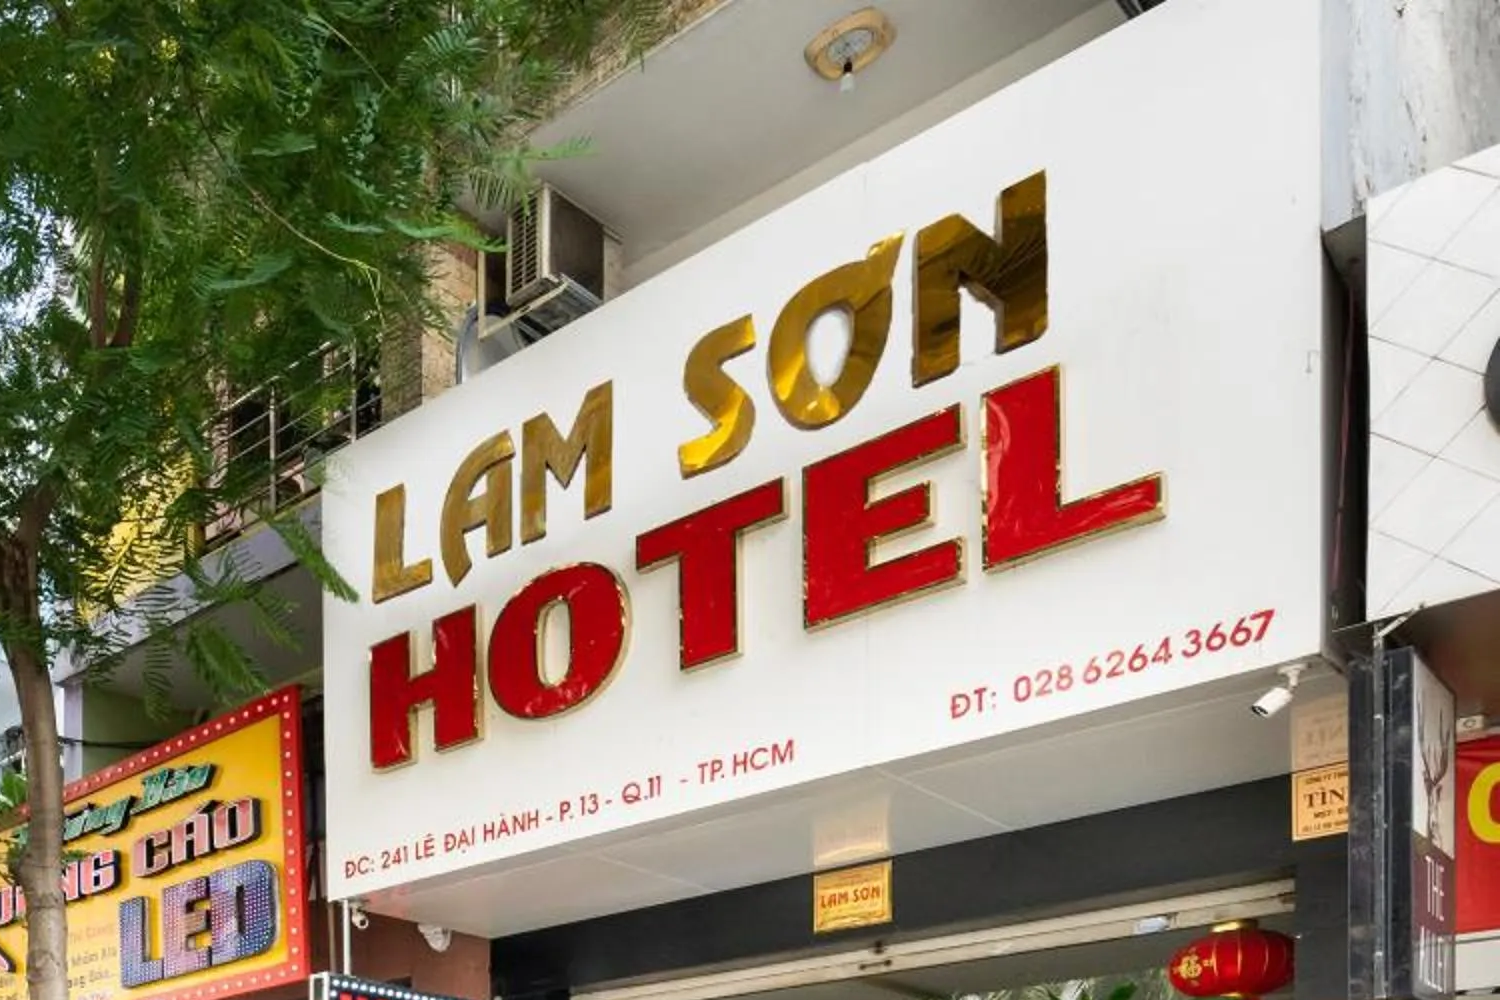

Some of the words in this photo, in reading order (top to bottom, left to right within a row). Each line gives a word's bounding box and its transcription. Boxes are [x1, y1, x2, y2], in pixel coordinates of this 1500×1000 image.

[372, 380, 614, 603] LAM
[679, 169, 1049, 479] SƠN
[368, 364, 1167, 773] HOTEL
[950, 687, 997, 719] ĐT:
[1013, 664, 1074, 703] 028
[1083, 636, 1174, 684] 6264
[1181, 608, 1276, 658] 3667
[133, 796, 260, 878] CÁO
[344, 857, 375, 878] ĐC:
[380, 845, 409, 869] 241
[443, 827, 475, 855] ĐẠI
[482, 808, 540, 841] HÀNH
[732, 739, 796, 776] HCM
[118, 860, 280, 989] LED
[1425, 855, 1445, 922] THE
